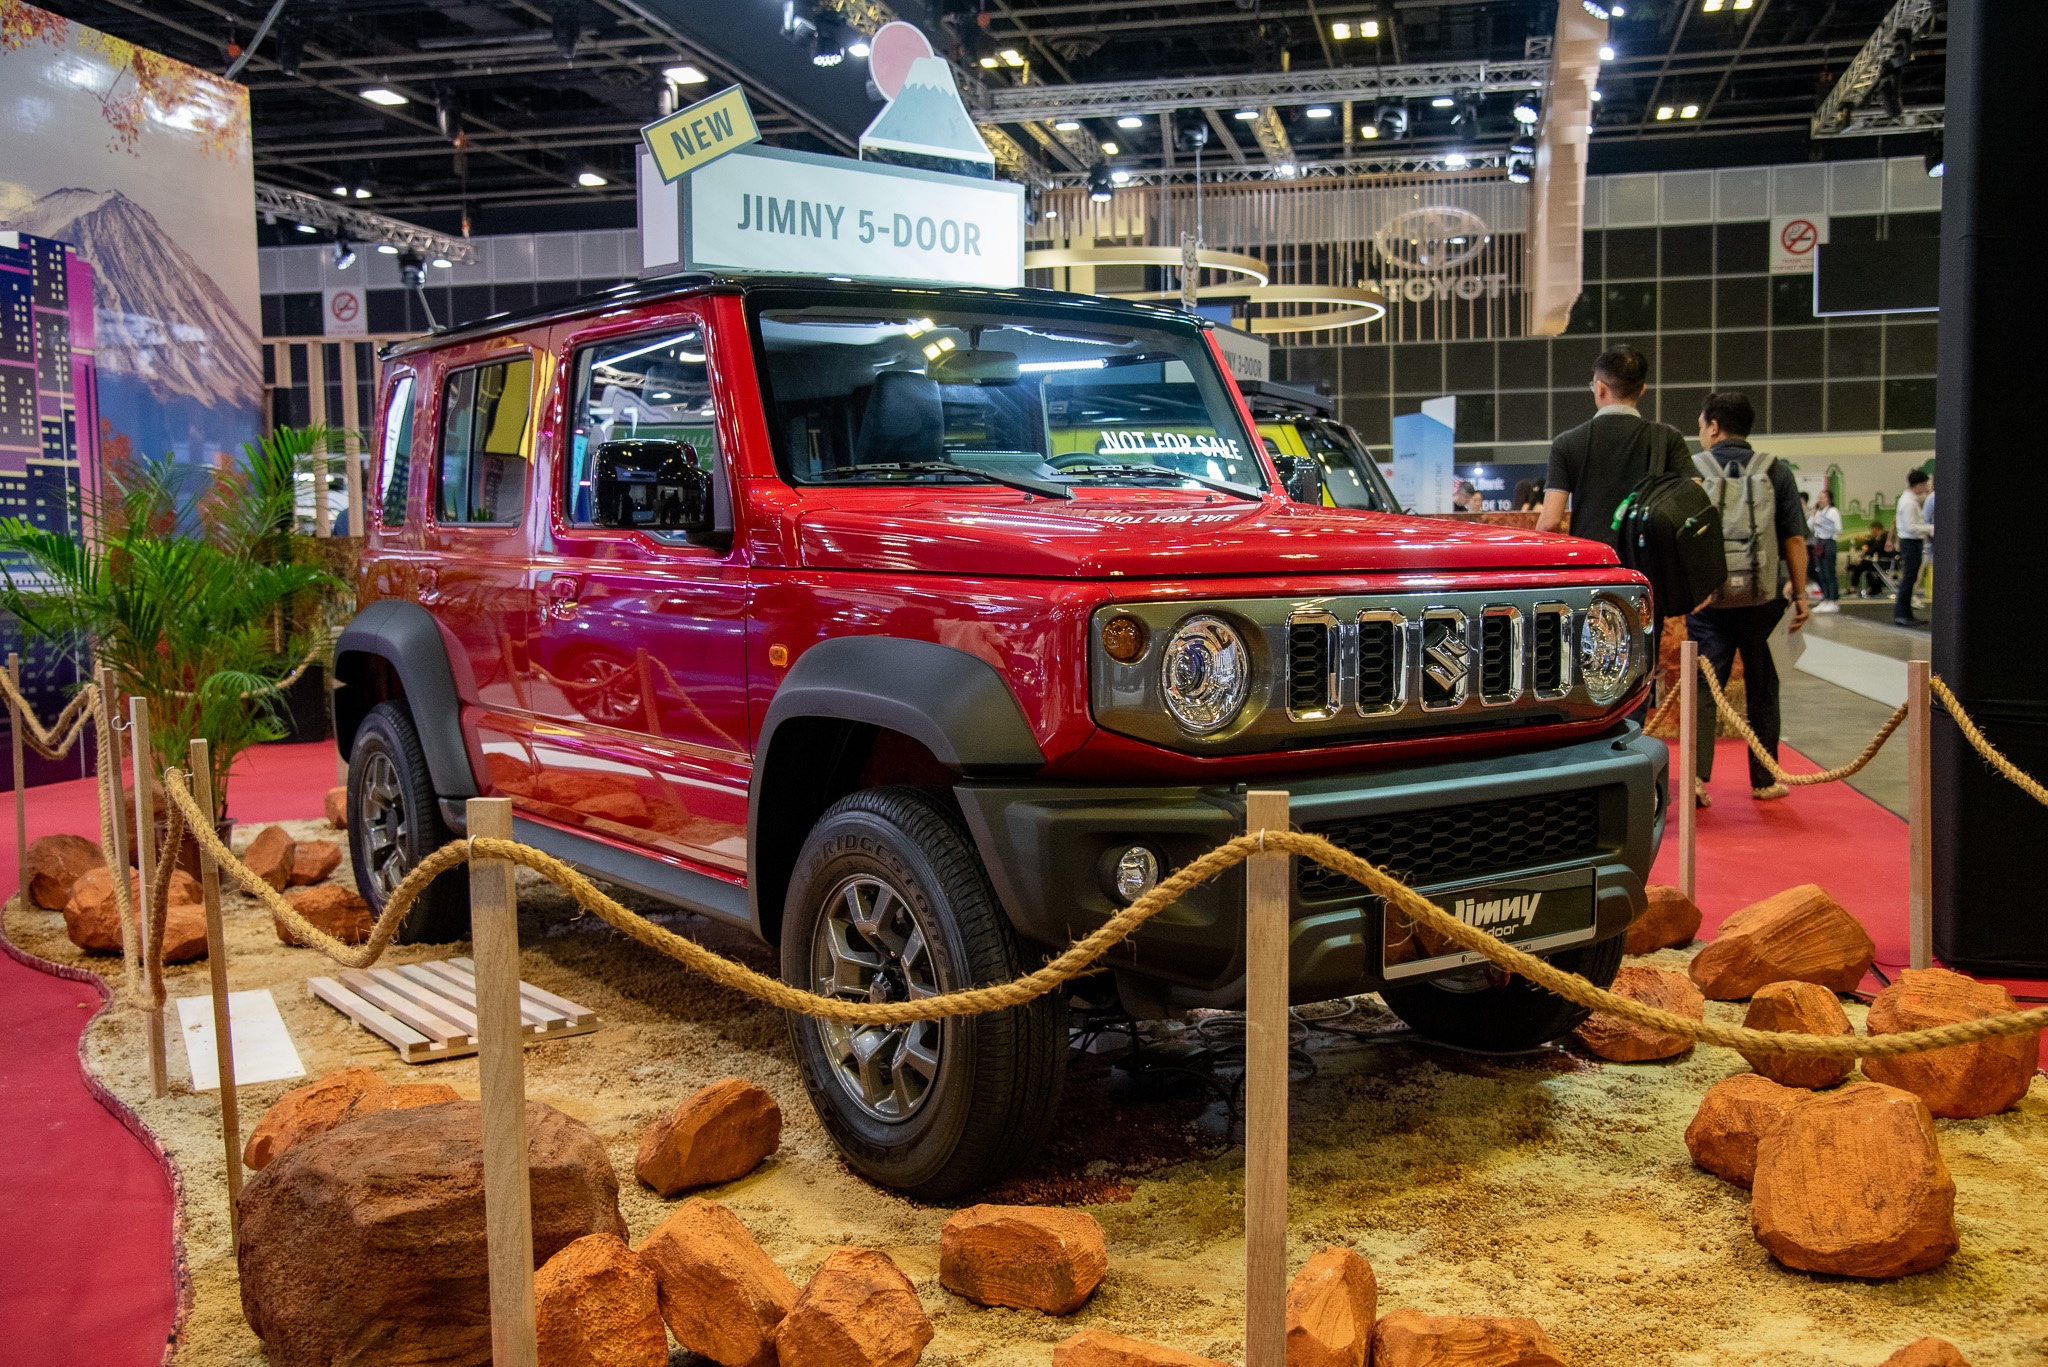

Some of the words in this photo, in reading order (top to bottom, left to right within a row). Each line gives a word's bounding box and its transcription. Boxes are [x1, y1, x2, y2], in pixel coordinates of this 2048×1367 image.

[670, 107, 735, 160] NEW
[737, 193, 845, 240] JIMNY
[858, 209, 982, 257] 5-DOOR
[1101, 430, 1147, 452] NOT
[1151, 431, 1197, 455] FOR
[1195, 434, 1244, 461] SALE
[808, 832, 952, 974] BRIDGESTONE
[1455, 893, 1541, 926] Jimny
[1486, 924, 1519, 937] door
